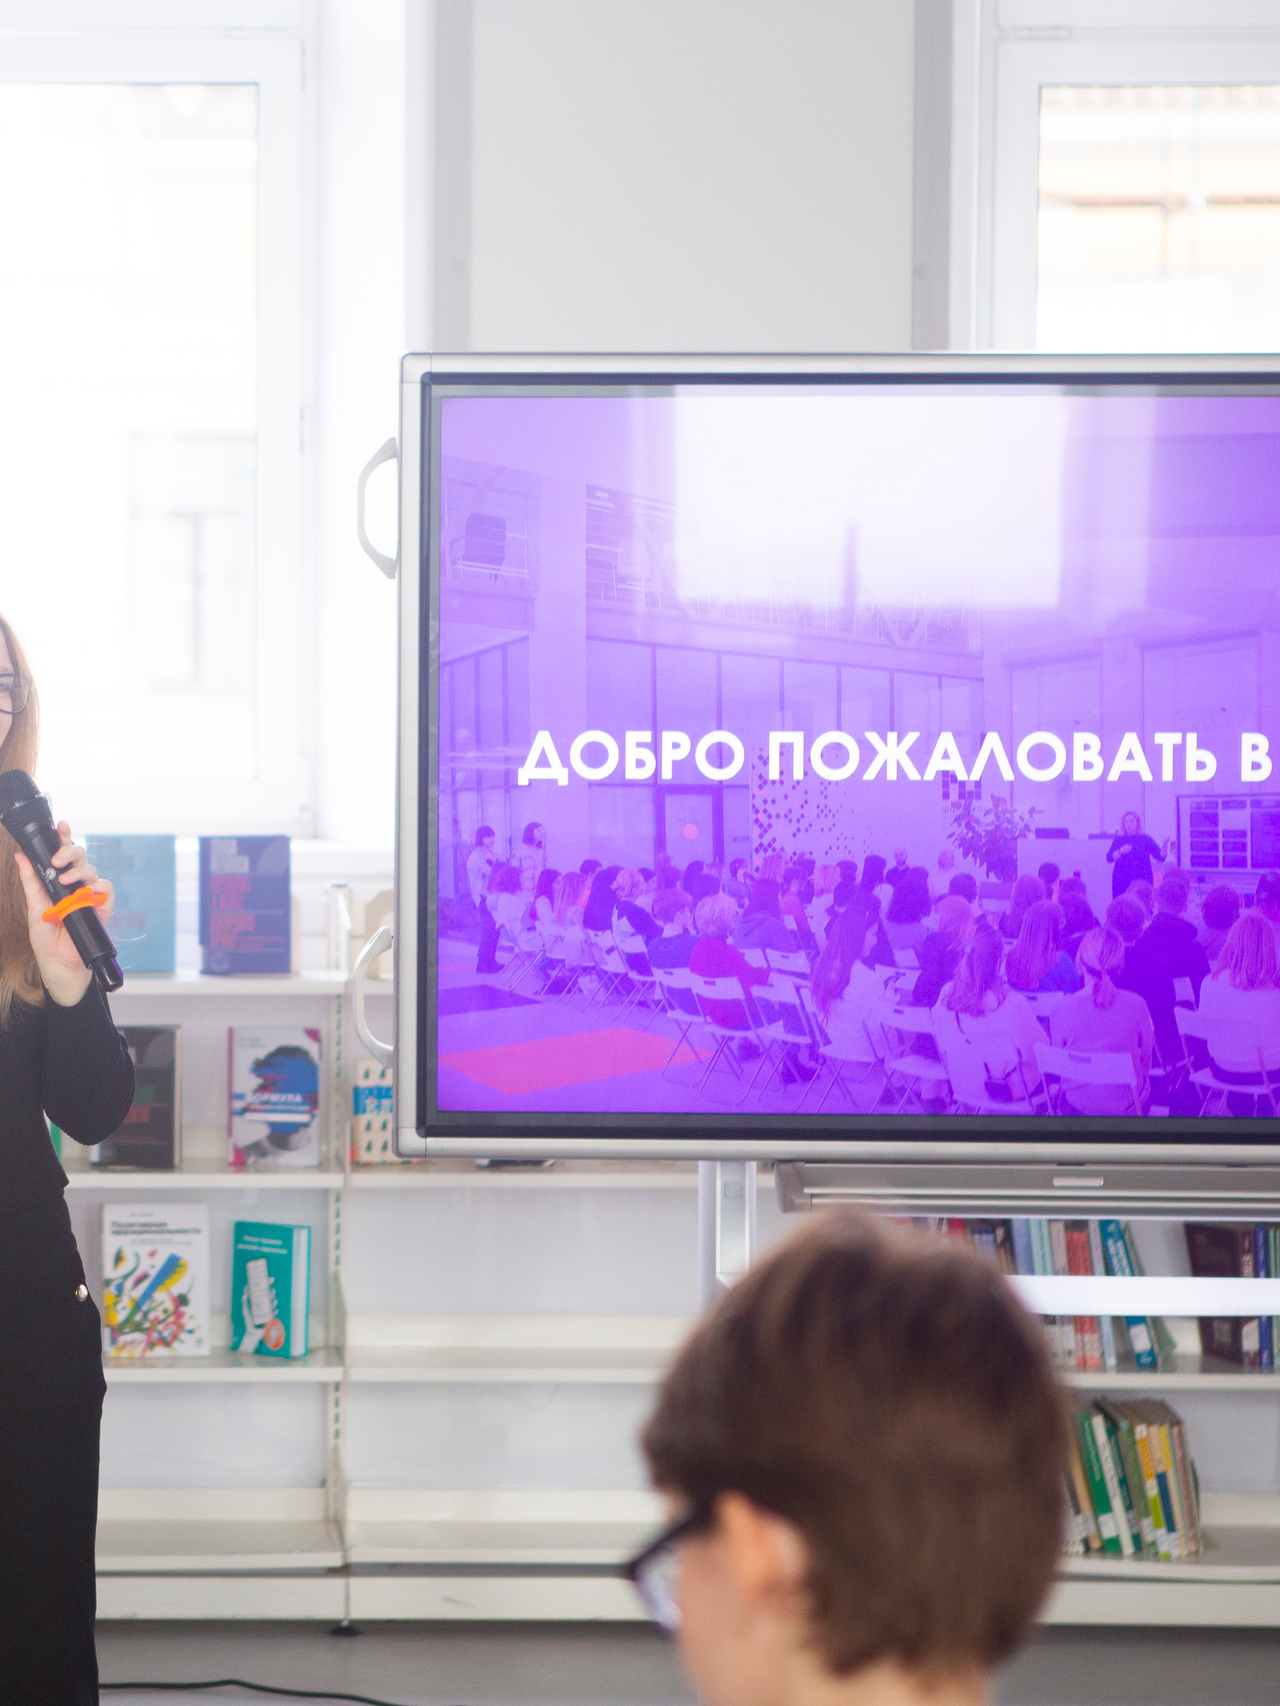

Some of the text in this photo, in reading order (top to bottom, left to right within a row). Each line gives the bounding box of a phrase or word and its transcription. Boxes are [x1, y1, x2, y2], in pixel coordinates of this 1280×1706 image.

[517, 730, 1273, 786] ДОБРО ПОЖАЛОВАТЬ В
